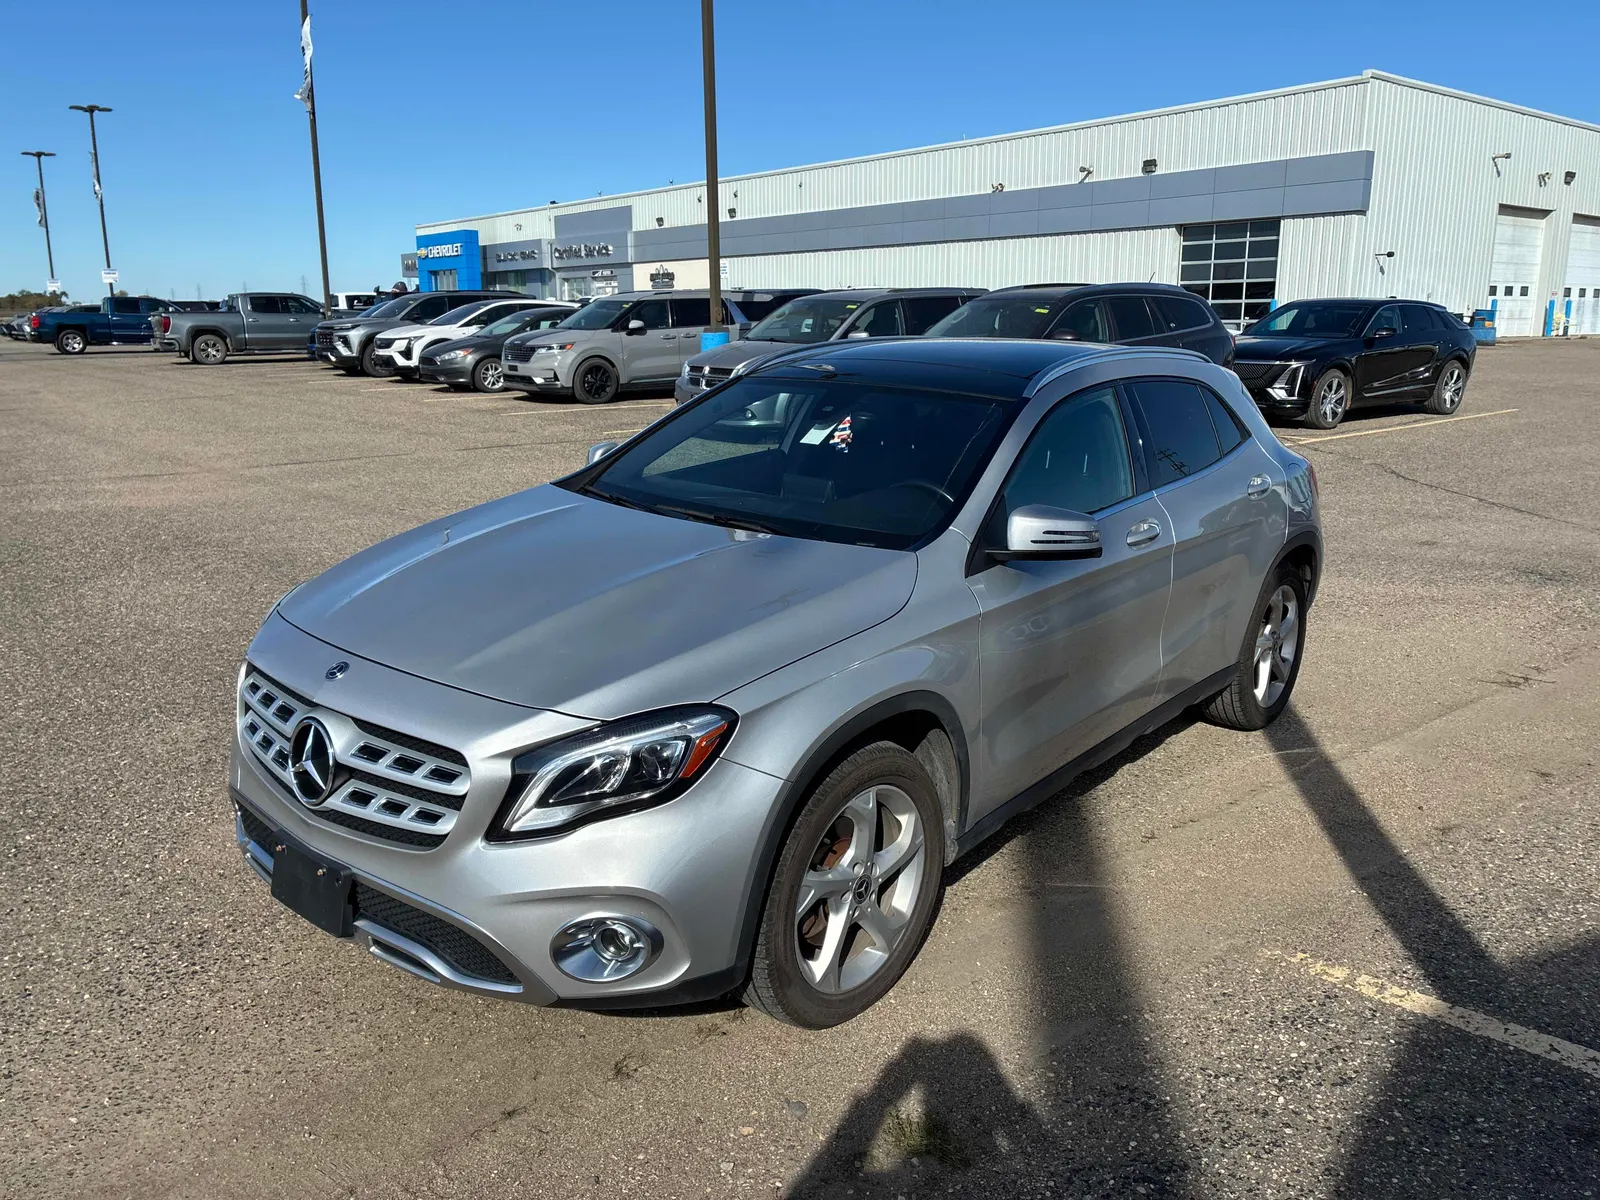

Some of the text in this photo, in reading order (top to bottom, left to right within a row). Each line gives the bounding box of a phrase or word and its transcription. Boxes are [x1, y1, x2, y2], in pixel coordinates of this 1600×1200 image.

[428, 243, 462, 258] CHEVROLET
[554, 242, 613, 260] Certified Service
